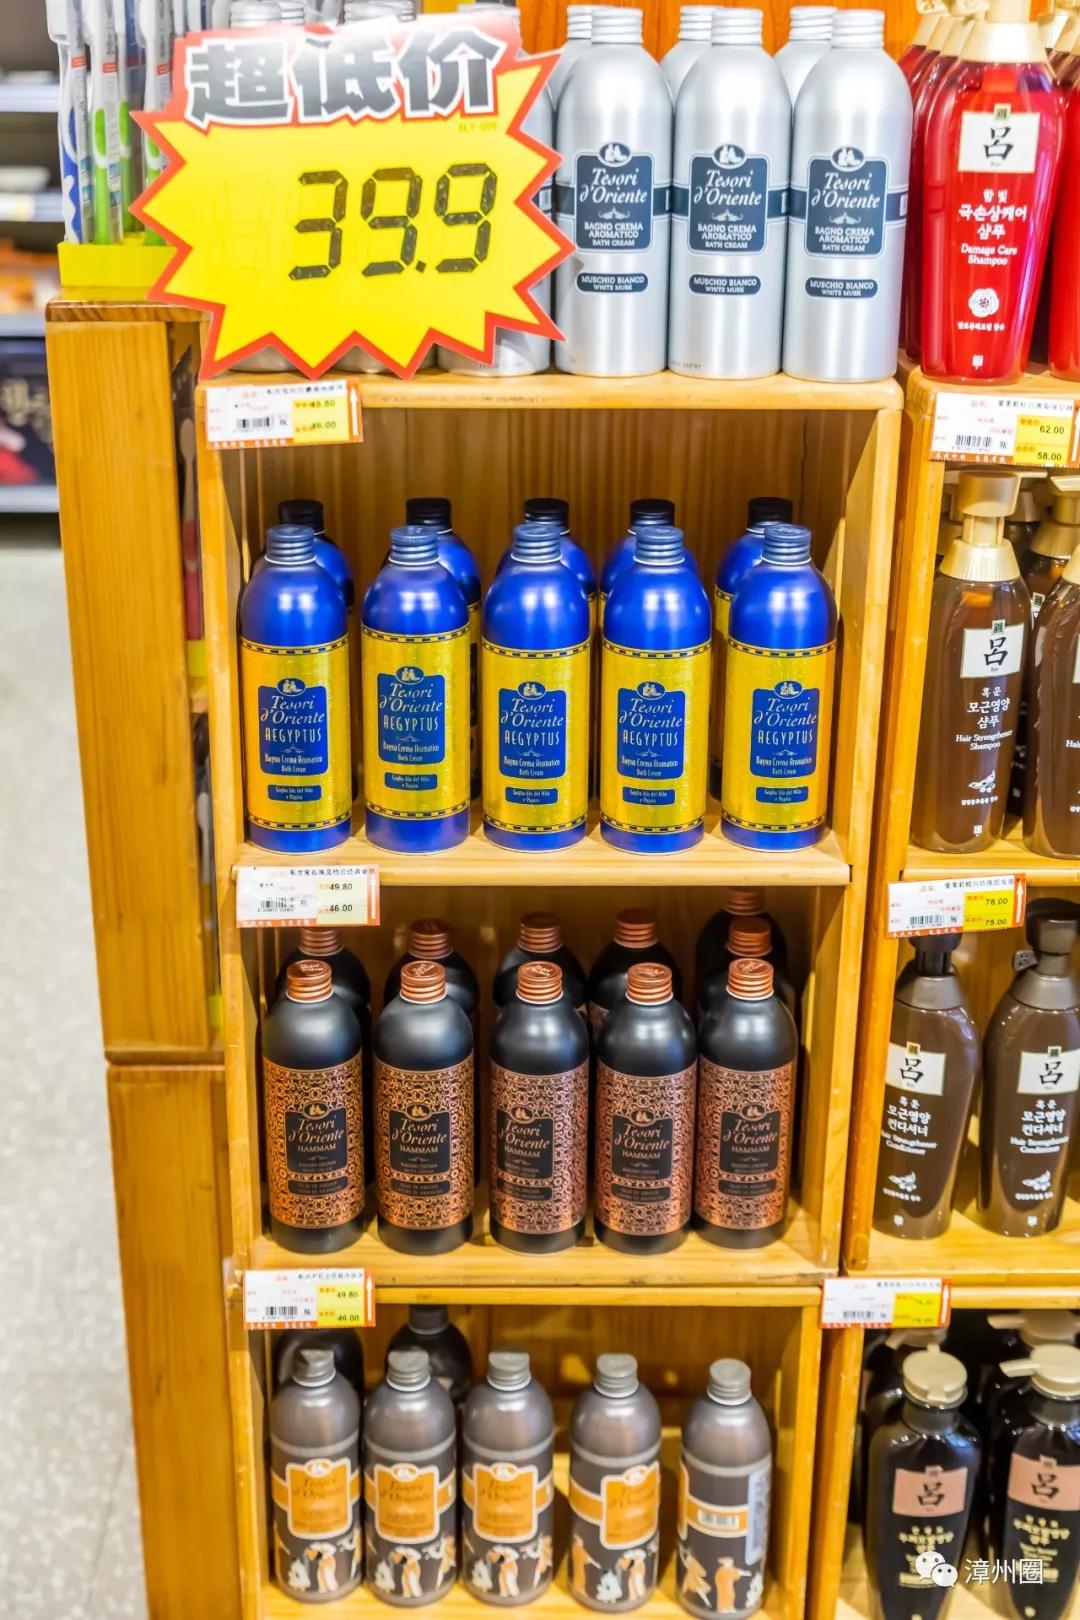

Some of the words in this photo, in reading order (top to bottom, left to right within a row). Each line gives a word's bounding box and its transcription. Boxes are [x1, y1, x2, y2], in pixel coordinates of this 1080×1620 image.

[187, 28, 505, 126] 超低价
[592, 168, 639, 185] Tesori
[707, 170, 754, 188] Tesori
[825, 172, 872, 190] Tesori
[580, 184, 647, 204] d'Oriente
[694, 186, 762, 205] d'Oriente
[811, 189, 880, 208] d'Oriente
[289, 162, 497, 281] 39.9
[584, 222, 612, 230] BAGNO
[615, 222, 643, 231] CREMA
[698, 224, 725, 232] BAGNO
[728, 225, 756, 233] CREMA
[815, 227, 843, 235] BAGNO
[845, 228, 874, 236] CREMA
[977, 223, 1006, 240] 샴푸
[961, 243, 995, 256] Damage
[998, 245, 1018, 255] Care
[968, 254, 1008, 267] Shampoo
[581, 276, 615, 284] MUSCHIO
[617, 276, 644, 284] BIANCO
[694, 277, 727, 285] MUSCHIO
[810, 281, 843, 289] MUSCHIO
[1040, 425, 1065, 434] 62.00
[1037, 452, 1062, 461] 58.00
[390, 683, 434, 698] Tesori
[271, 694, 316, 709] Tesori
[379, 695, 443, 713] d'Oriente
[511, 699, 555, 713] Tesori
[630, 699, 674, 713] Tesori
[768, 697, 811, 711] Tesori
[967, 698, 1010, 714] 모근영양
[260, 708, 325, 724] d'Oriente
[383, 715, 439, 731] AEGYPTUS
[500, 711, 564, 728] d'Oriente
[619, 711, 683, 728] d'Oriente
[754, 710, 817, 727] d'Oriente
[977, 715, 1000, 729] 샴푸
[265, 728, 322, 742] AEGYPTUS
[504, 730, 560, 746] AEGYPTUS
[623, 730, 678, 746] AEGYPTUS
[758, 729, 813, 745] AEGYPTUS
[955, 734, 972, 742] Hair
[970, 742, 1001, 752] Shampoo
[329, 904, 353, 912] 46.00
[299, 1115, 337, 1132] Tesori
[400, 1118, 439, 1132] Tesori
[505, 1120, 542, 1136] Tesori
[624, 1123, 663, 1138] Tesori
[735, 1117, 772, 1132] Tesori
[298, 1143, 336, 1153] HAMMAM
[400, 1145, 438, 1153] HAMMAM
[504, 1145, 540, 1158] HAMMAM
[622, 1151, 661, 1159] HAMMAM
[731, 1145, 770, 1153] HAMMAM
